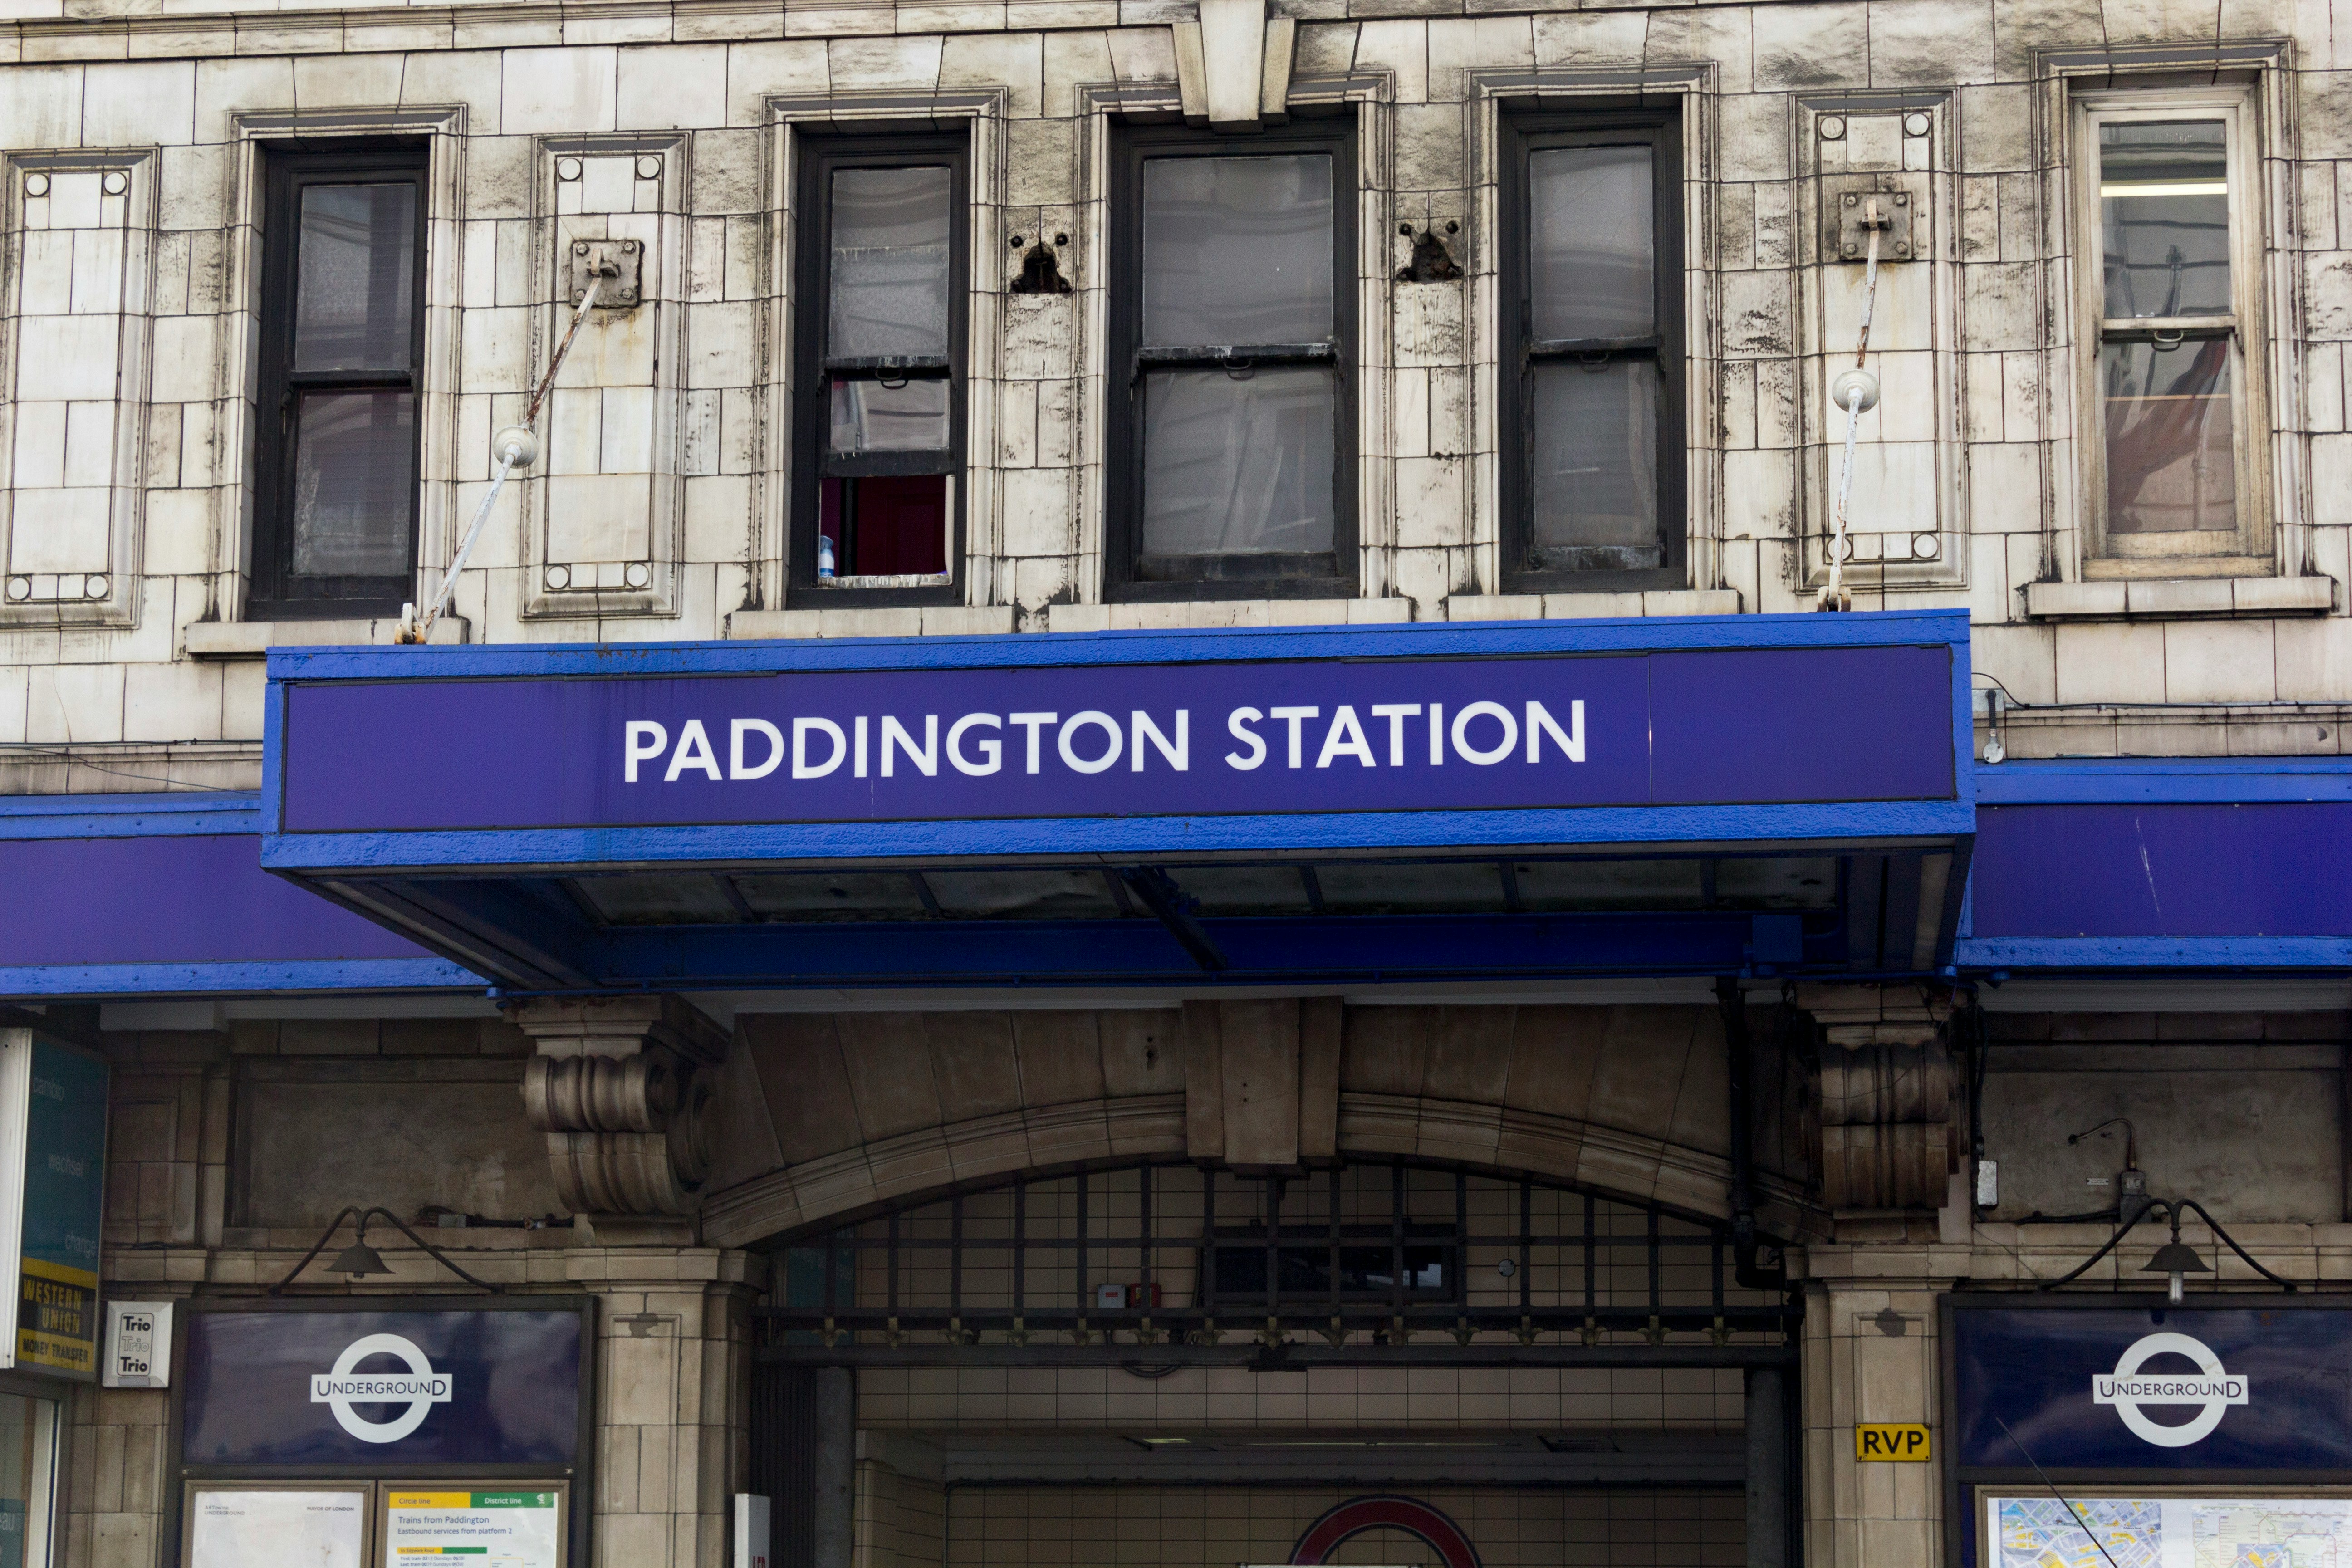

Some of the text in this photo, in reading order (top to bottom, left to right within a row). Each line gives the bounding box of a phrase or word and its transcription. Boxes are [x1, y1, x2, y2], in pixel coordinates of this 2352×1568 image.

[624, 700, 1586, 783] PADDINGTON STATION
[48, 1153, 83, 1178] wechsel
[65, 1232, 97, 1259] change
[23, 1278, 82, 1310] WESTERN
[42, 1308, 80, 1334] UNION
[123, 1316, 151, 1331] Trio
[23, 1338, 88, 1363] MONEY TRANSFER
[122, 1336, 149, 1352] Trio
[120, 1357, 148, 1372] Trio
[317, 1380, 446, 1396] UNDERGROUND
[2100, 1381, 2241, 1398] UNDERGROUND
[1864, 1431, 1923, 1454] RVP
[445, 1516, 489, 1525] Paddington
